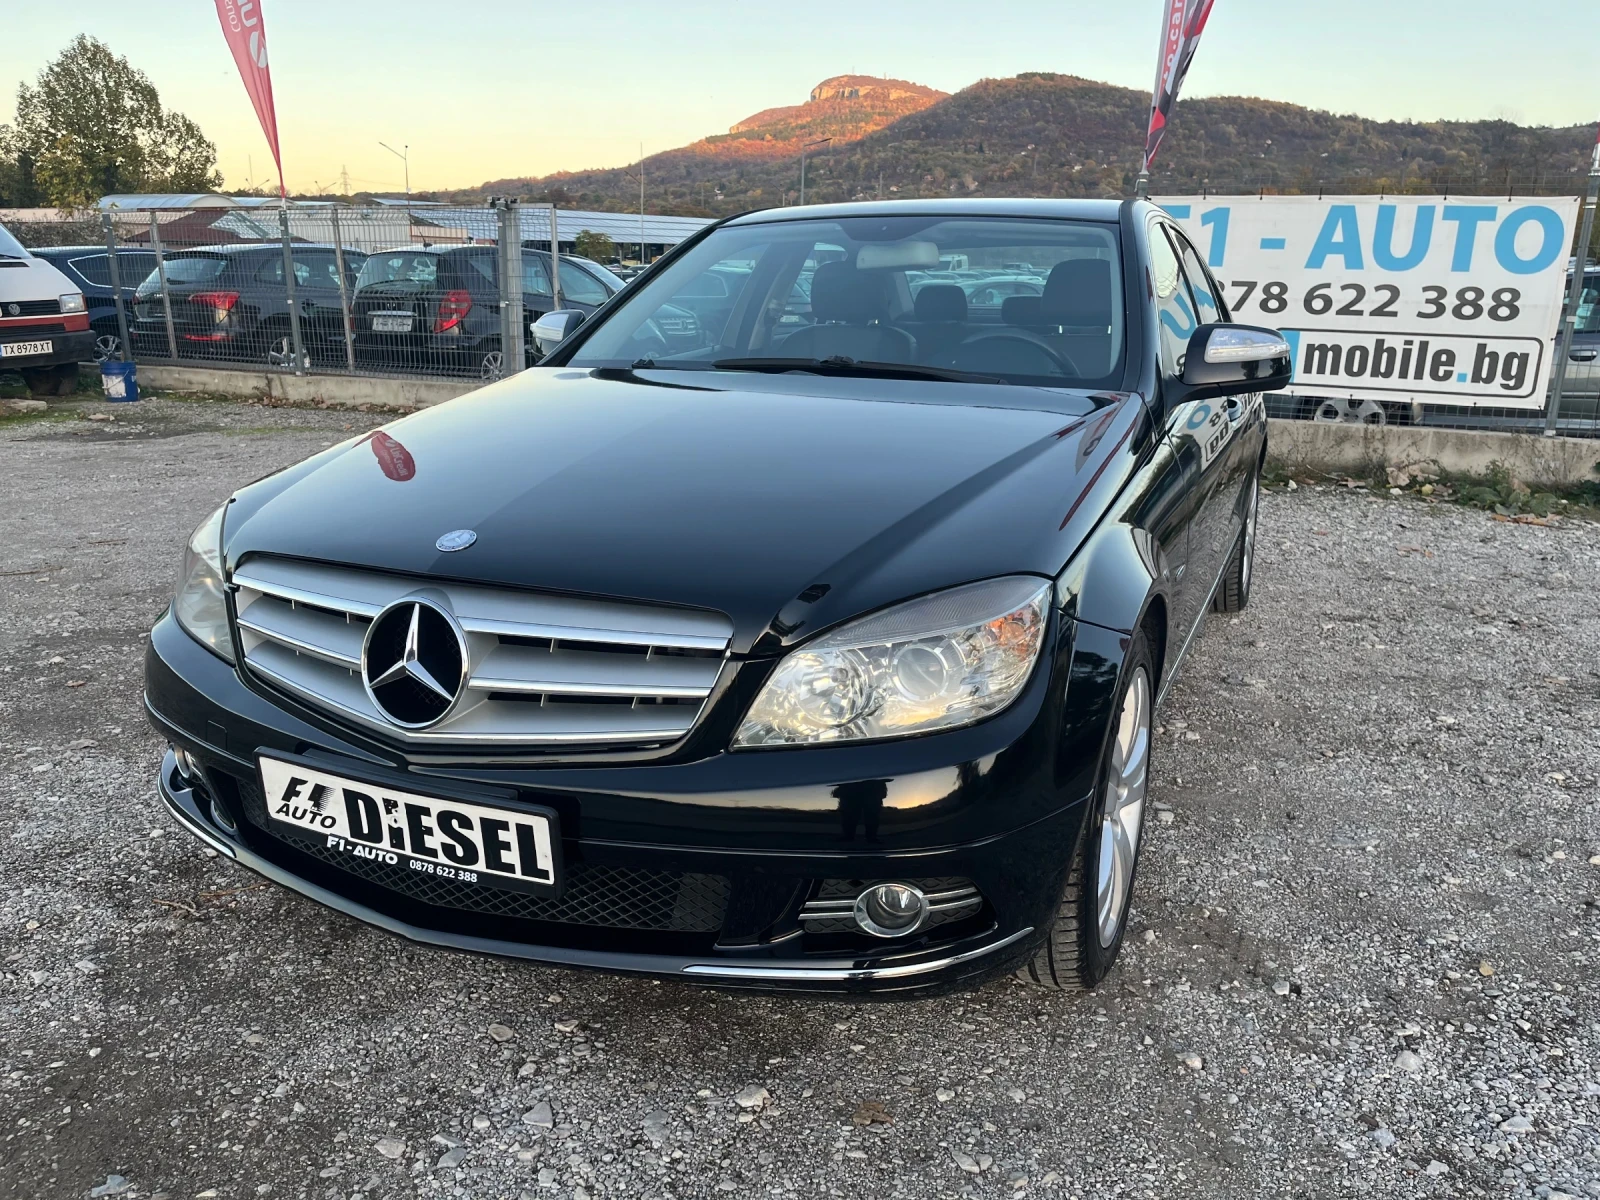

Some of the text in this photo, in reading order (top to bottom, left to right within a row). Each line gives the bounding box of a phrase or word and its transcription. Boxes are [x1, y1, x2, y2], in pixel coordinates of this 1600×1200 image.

[1160, 204, 1231, 267] 1
[1304, 204, 1566, 276] AUTO
[1217, 280, 1289, 314] 78
[1302, 282, 1402, 318] 622
[1416, 285, 1522, 322] 388
[1302, 339, 1530, 391] mobile.bg
[275, 800, 337, 830] AUTO
[409, 859, 478, 883] 0878 622 388
